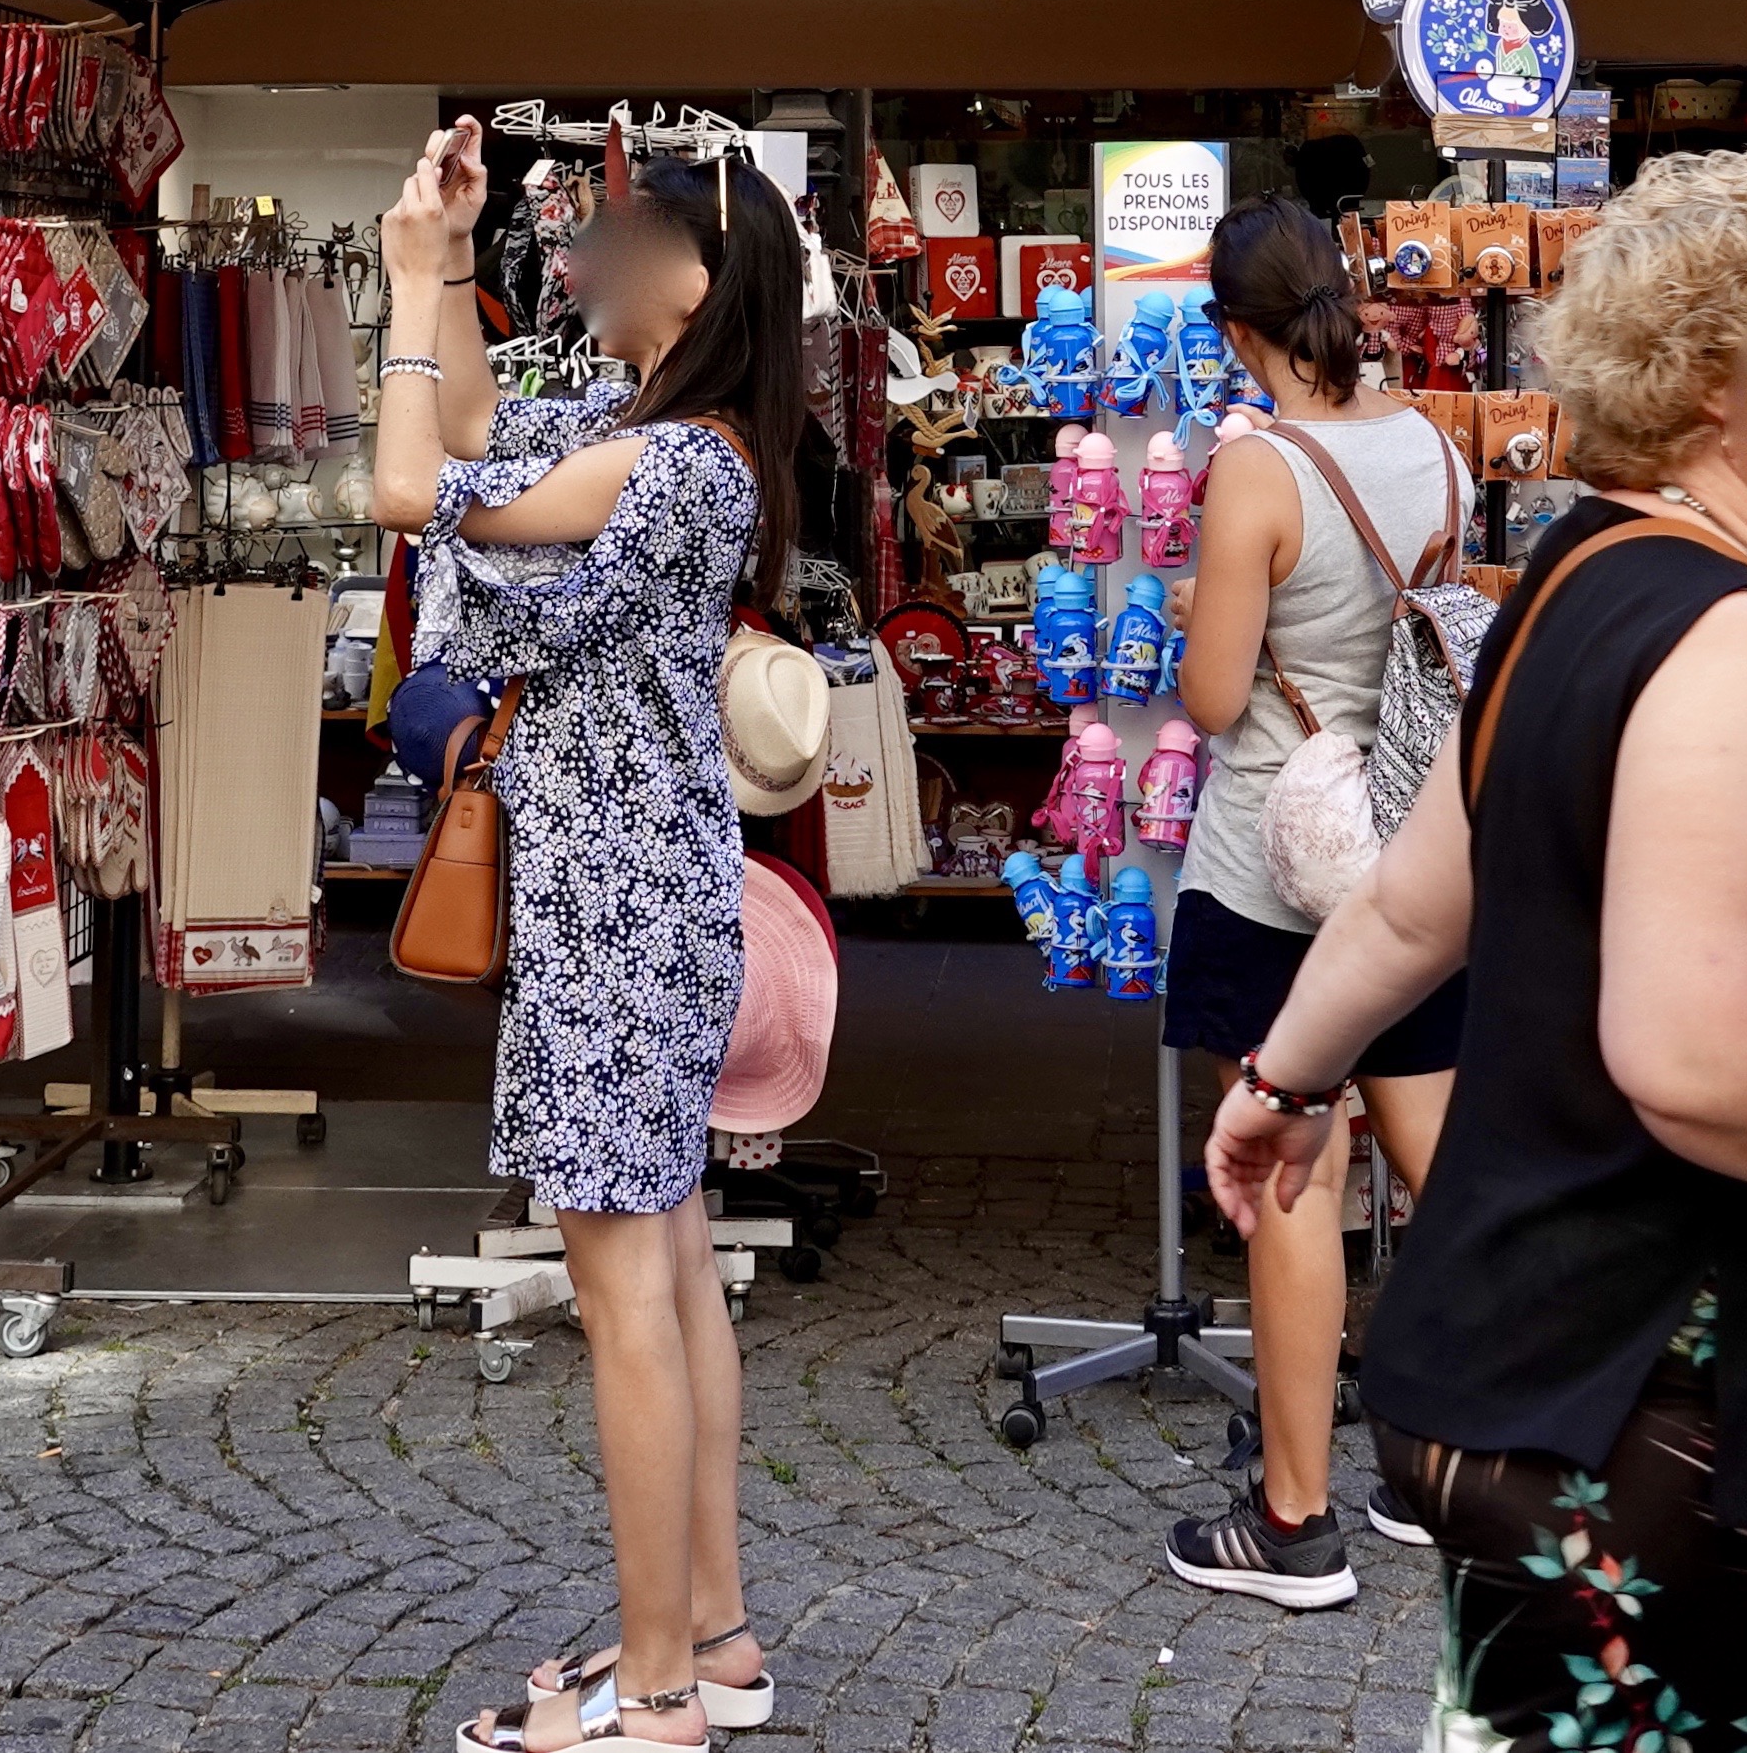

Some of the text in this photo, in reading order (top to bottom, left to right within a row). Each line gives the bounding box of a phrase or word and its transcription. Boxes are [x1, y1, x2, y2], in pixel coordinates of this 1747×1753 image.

[1459, 87, 1505, 114] Alsace
[1123, 173, 1209, 189] TOUS LES
[1123, 194, 1209, 209] PRENOMS
[947, 252, 978, 265] Alsace
[1039, 257, 1074, 270] Alsace
[831, 798, 867, 810] ALSACE
